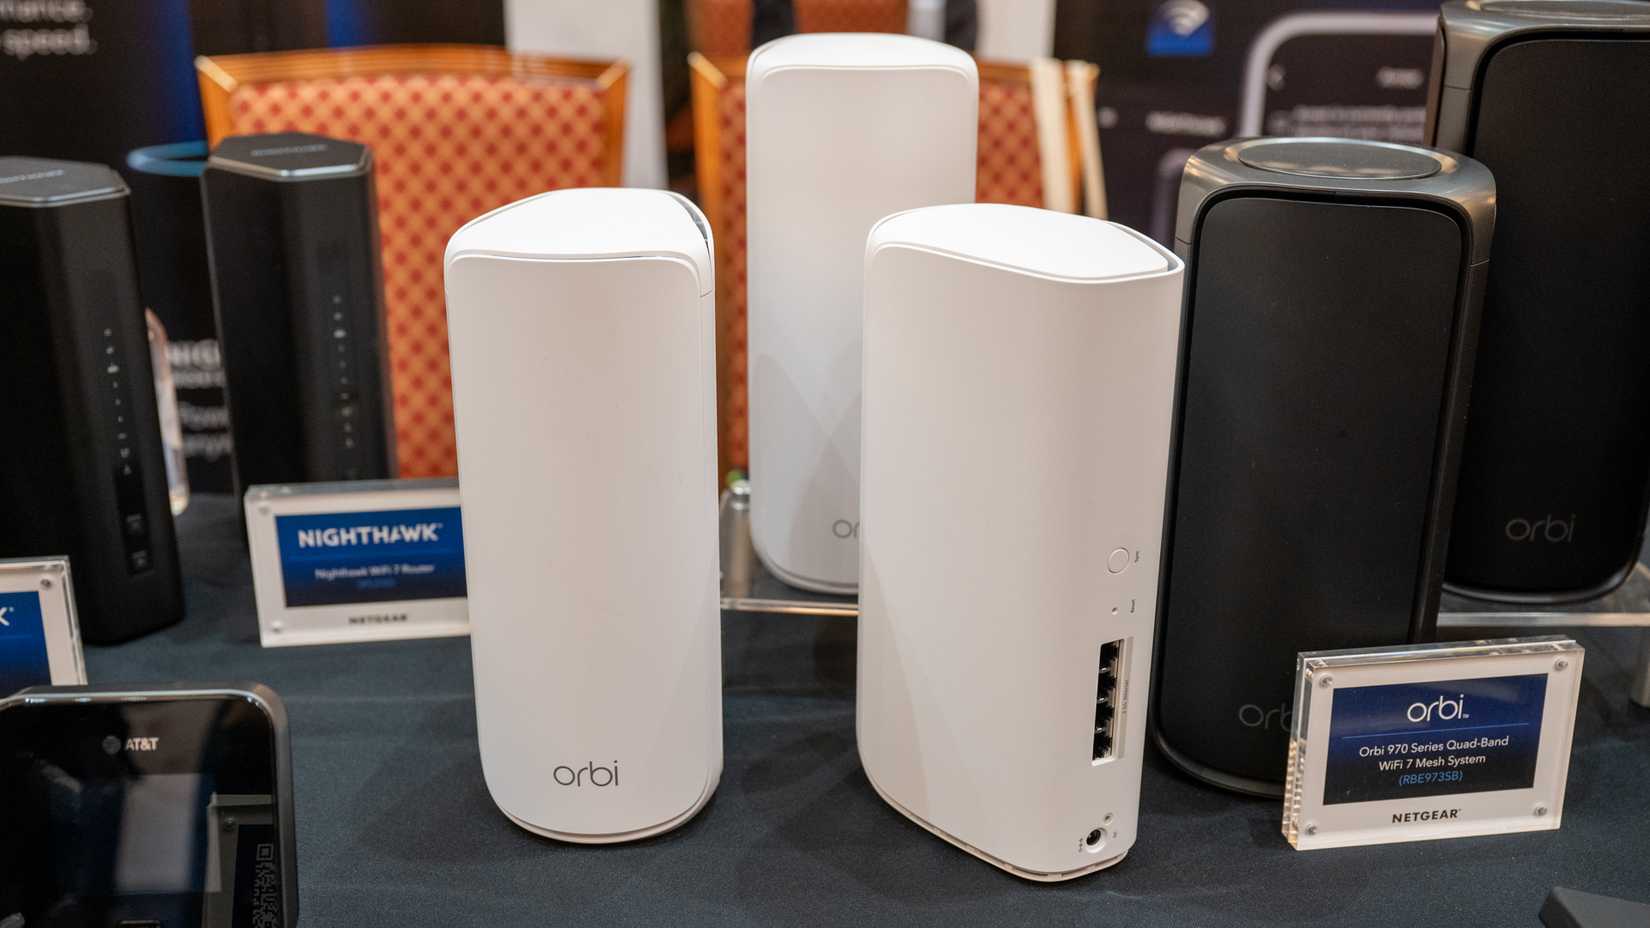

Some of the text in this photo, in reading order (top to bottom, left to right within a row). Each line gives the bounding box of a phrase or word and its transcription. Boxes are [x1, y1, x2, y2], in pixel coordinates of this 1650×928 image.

[297, 523, 440, 548] NIGHTHAWK
[1505, 513, 1577, 543] orbi
[348, 614, 408, 625] NETGEAR
[1407, 693, 1465, 722] orbi
[125, 737, 159, 751] AT&T
[1359, 735, 1509, 758] Orbi 970 Series Quad-Band
[1379, 754, 1486, 771] WiFi 7 Mesh System
[553, 760, 619, 787] orbi
[1399, 770, 1464, 786] (RBE973SB)
[1391, 809, 1459, 824] NETGEAR
